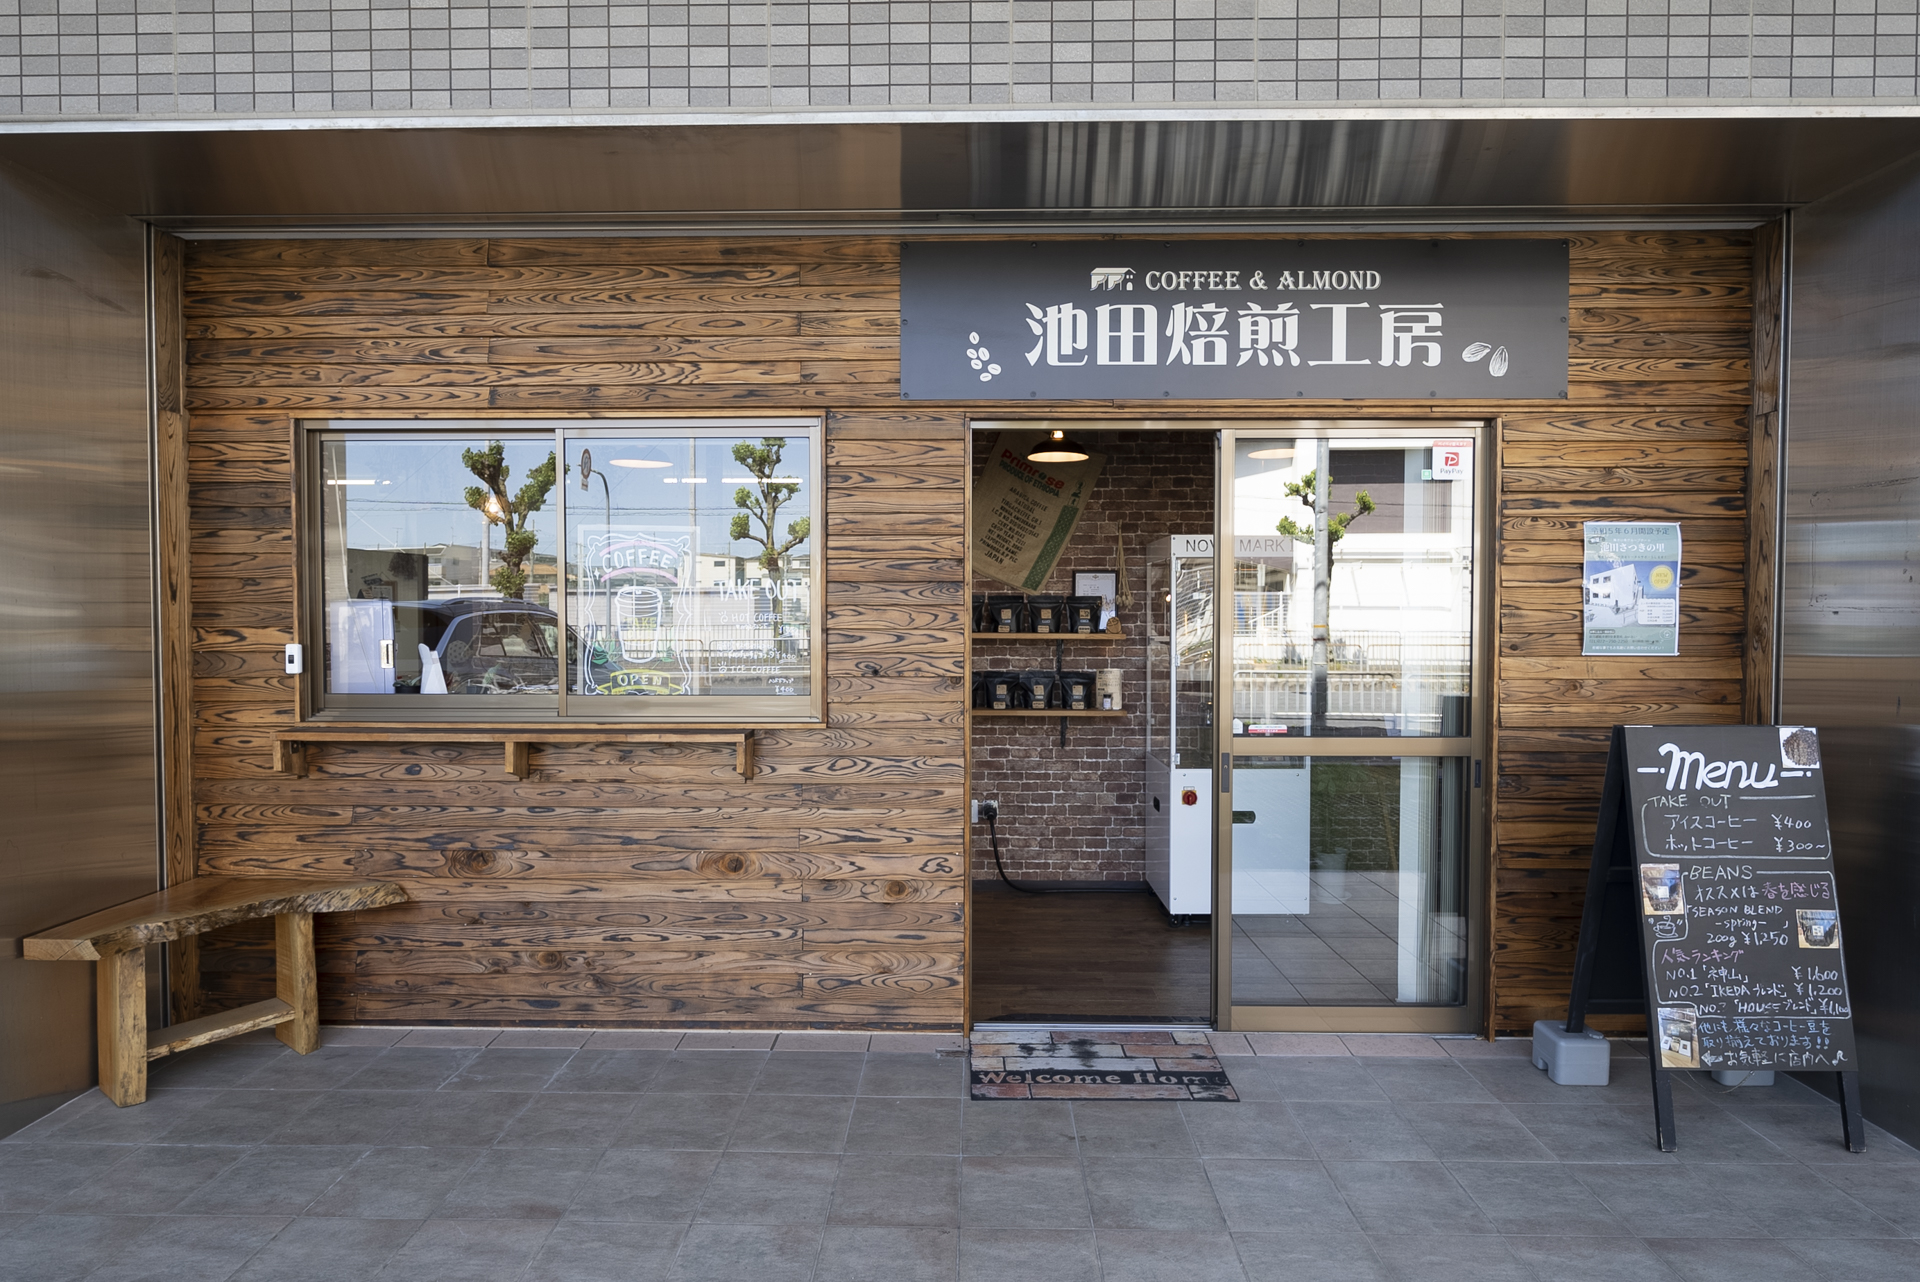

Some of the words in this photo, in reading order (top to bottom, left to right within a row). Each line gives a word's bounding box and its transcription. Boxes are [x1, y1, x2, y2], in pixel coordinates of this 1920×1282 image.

[1145, 270, 1241, 291] COFFEE
[1249, 270, 1268, 291] &
[1277, 270, 1382, 291] ALMOND
[1024, 301, 1445, 368] 池田焙煎工房
[1001, 449, 1064, 489] Primrose
[999, 460, 1024, 480] PRODUCE
[1024, 475, 1033, 485] OF
[1032, 479, 1060, 497] ETHIOPIA
[1239, 539, 1285, 552] MARK
[603, 548, 673, 573] COFFEE
[985, 550, 1004, 565] JAPAN
[716, 578, 760, 602] TAKE
[765, 578, 802, 603] OUT
[731, 613, 750, 622] HOT
[753, 613, 783, 622] COFFEE
[730, 664, 748, 673] ICE
[751, 665, 782, 674] COFFEE
[617, 673, 662, 686] OPEN
[1658, 743, 1779, 791] Menu
[1647, 794, 1688, 808] TAKE
[1700, 794, 1731, 809] OUT
[1664, 814, 1757, 830] アイスコーヒー
[1771, 814, 1812, 830] ¥400
[1666, 834, 1754, 851] ホットコーヒー
[1689, 865, 1753, 881] BEANS
[1744, 904, 1783, 915] BLEND
[1706, 933, 1737, 948] 200g
[1660, 948, 1744, 965] 人気ランキング
[1666, 967, 1698, 981] NO.1
[1668, 985, 1703, 998] NO.2
[979, 1071, 1121, 1085] Welcome
[1132, 1072, 1229, 1086] Home
